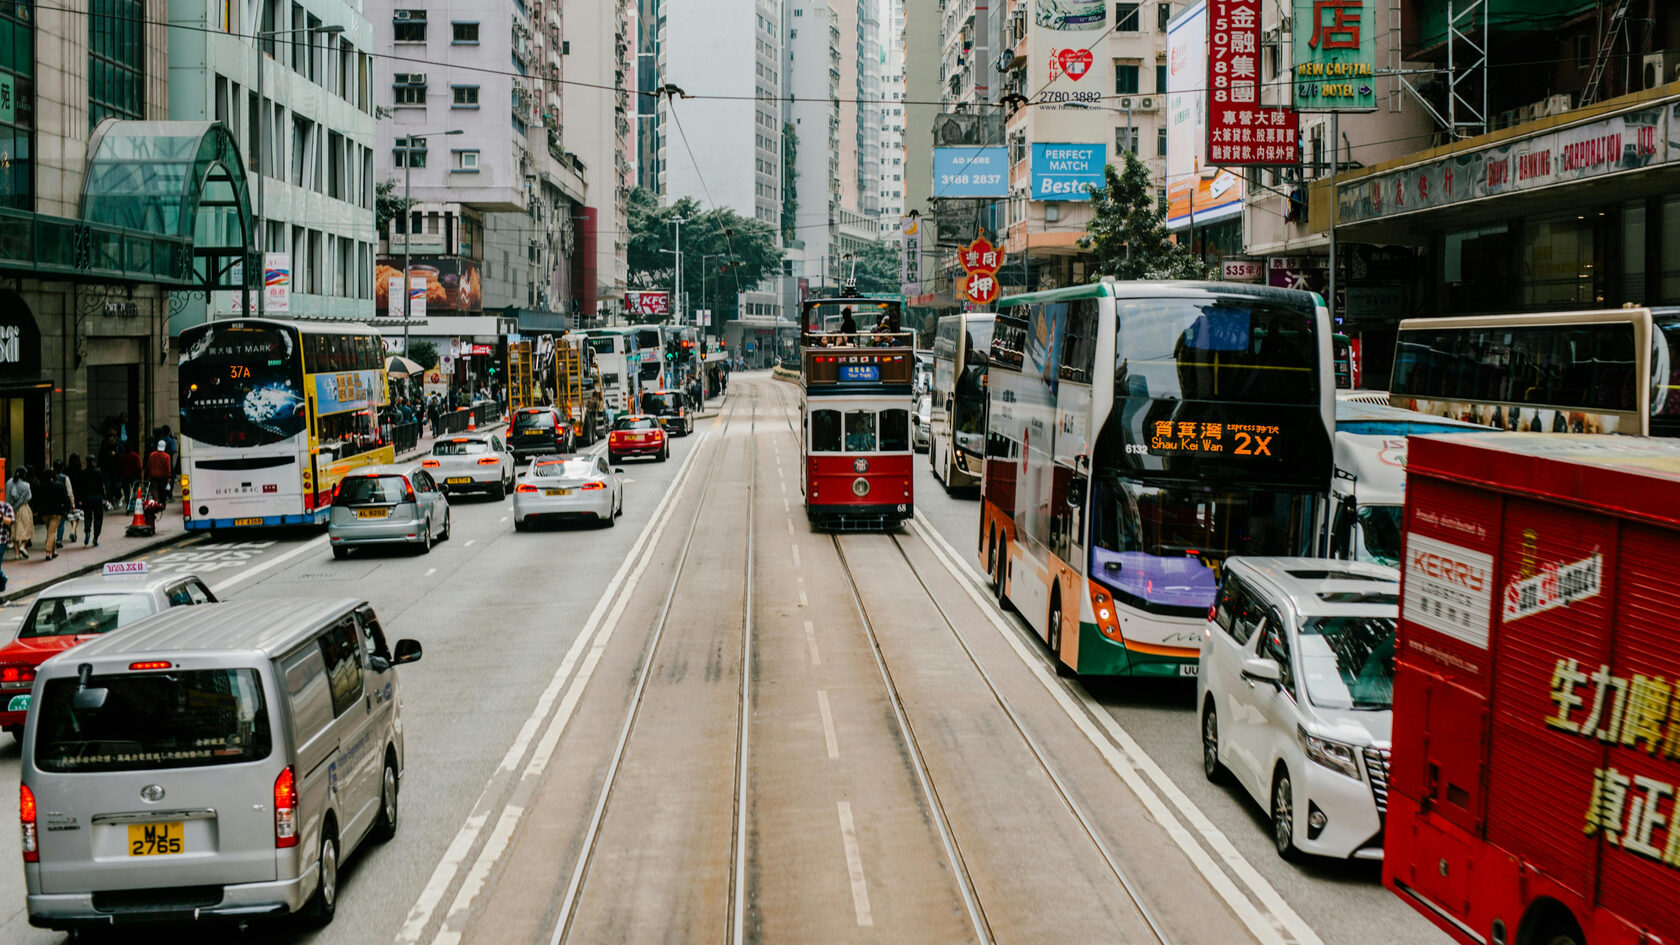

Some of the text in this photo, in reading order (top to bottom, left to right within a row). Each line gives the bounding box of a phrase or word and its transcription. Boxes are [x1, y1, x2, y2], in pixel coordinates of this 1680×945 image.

[1308, 0, 1363, 49] 店
[1214, 0, 1228, 102] 1507888
[1230, 0, 1255, 103] 金融集團
[1299, 62, 1373, 75] NEW CAPITAL
[1040, 91, 1102, 103] 2780 3882
[1299, 83, 1354, 97] 2/F HOTEL
[1222, 110, 1286, 126] 專營大陸
[1045, 150, 1093, 159] PERFECT
[1519, 149, 1550, 181] BANKING
[1563, 132, 1621, 171] CORPORATION
[1637, 125, 1657, 157] LTD.
[1050, 161, 1088, 170] MATCH
[942, 175, 1001, 184] 3188 2837
[968, 273, 994, 300] 押
[641, 295, 667, 305] KFC
[244, 344, 272, 353] MARK
[230, 365, 251, 379] 37A
[1125, 444, 1148, 455] 6132
[1151, 437, 1223, 452] Shau Kei Wan
[1233, 432, 1272, 456] 2X
[359, 509, 367, 517] AL
[897, 504, 906, 512] 68
[106, 563, 143, 573] TAXI
[1413, 549, 1485, 592] KERRY
[1184, 665, 1199, 675] UU
[1581, 766, 1680, 868] 真正
[144, 825, 169, 842] MJ
[132, 838, 181, 856] 2765
